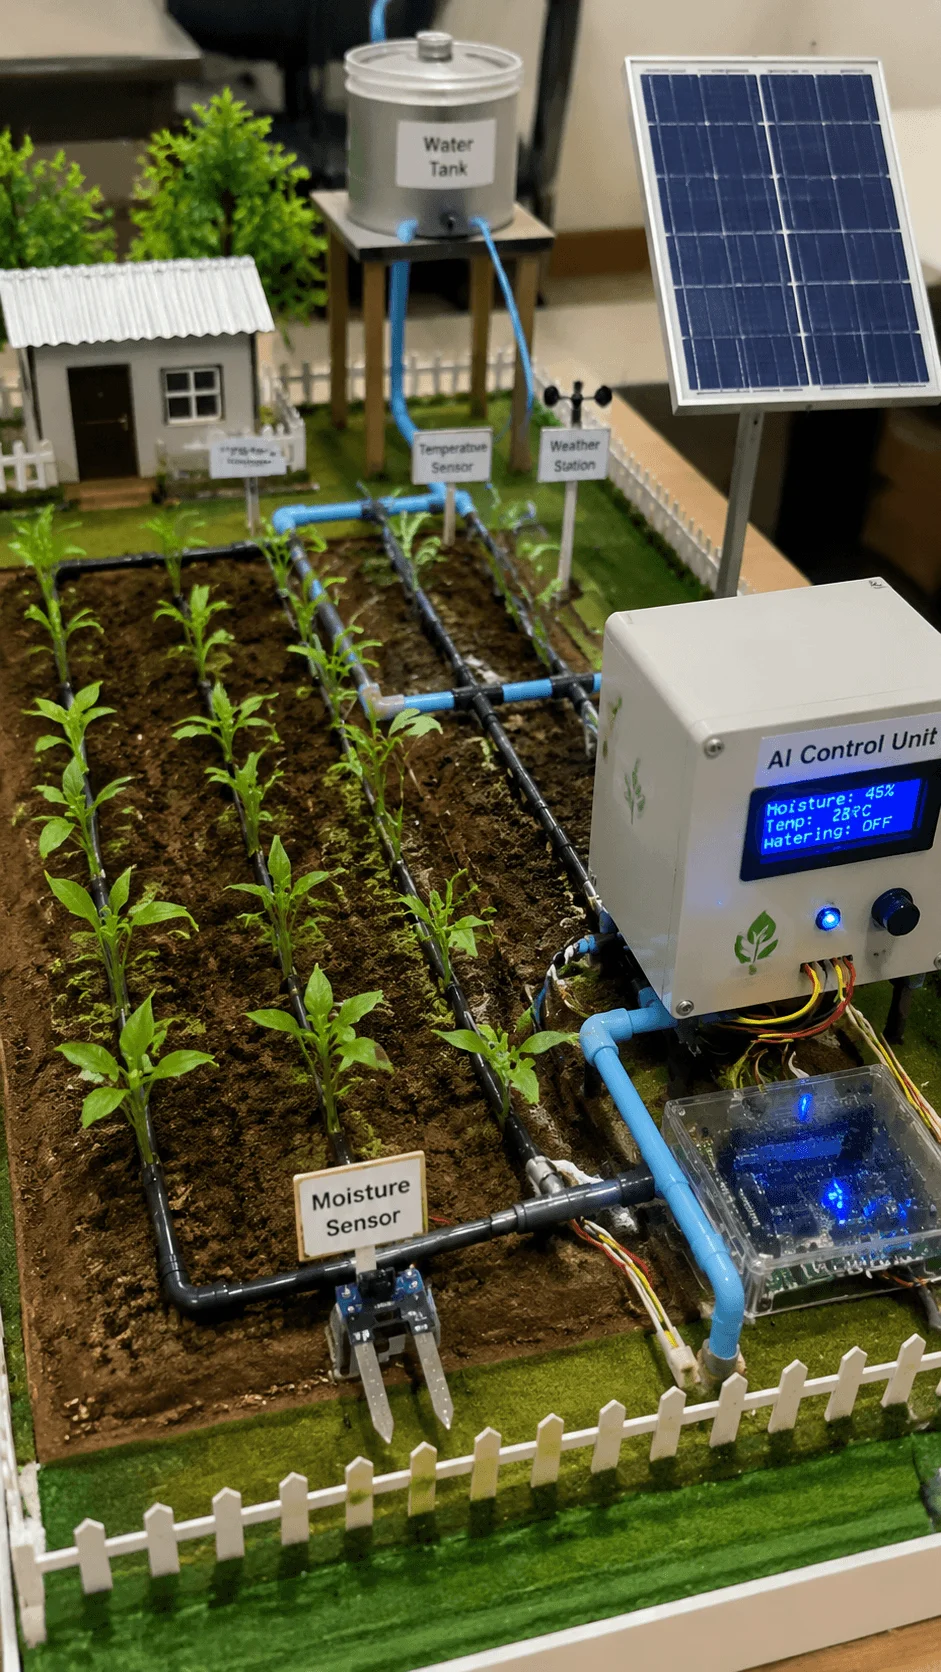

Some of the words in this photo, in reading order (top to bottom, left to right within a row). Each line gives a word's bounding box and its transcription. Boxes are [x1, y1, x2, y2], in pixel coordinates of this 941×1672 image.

[423, 136, 474, 153] Water
[429, 160, 468, 177] Tank
[549, 439, 600, 452] Weather
[431, 462, 474, 474] Sensor
[554, 460, 596, 473] Station
[767, 749, 792, 769] AI
[800, 734, 884, 764] Control
[892, 727, 938, 750] Unit
[865, 784, 895, 800] 45%
[766, 816, 812, 833] Temp:
[862, 815, 893, 832] OFF
[312, 1180, 410, 1211] Moisture
[326, 1209, 401, 1237] Sensor
